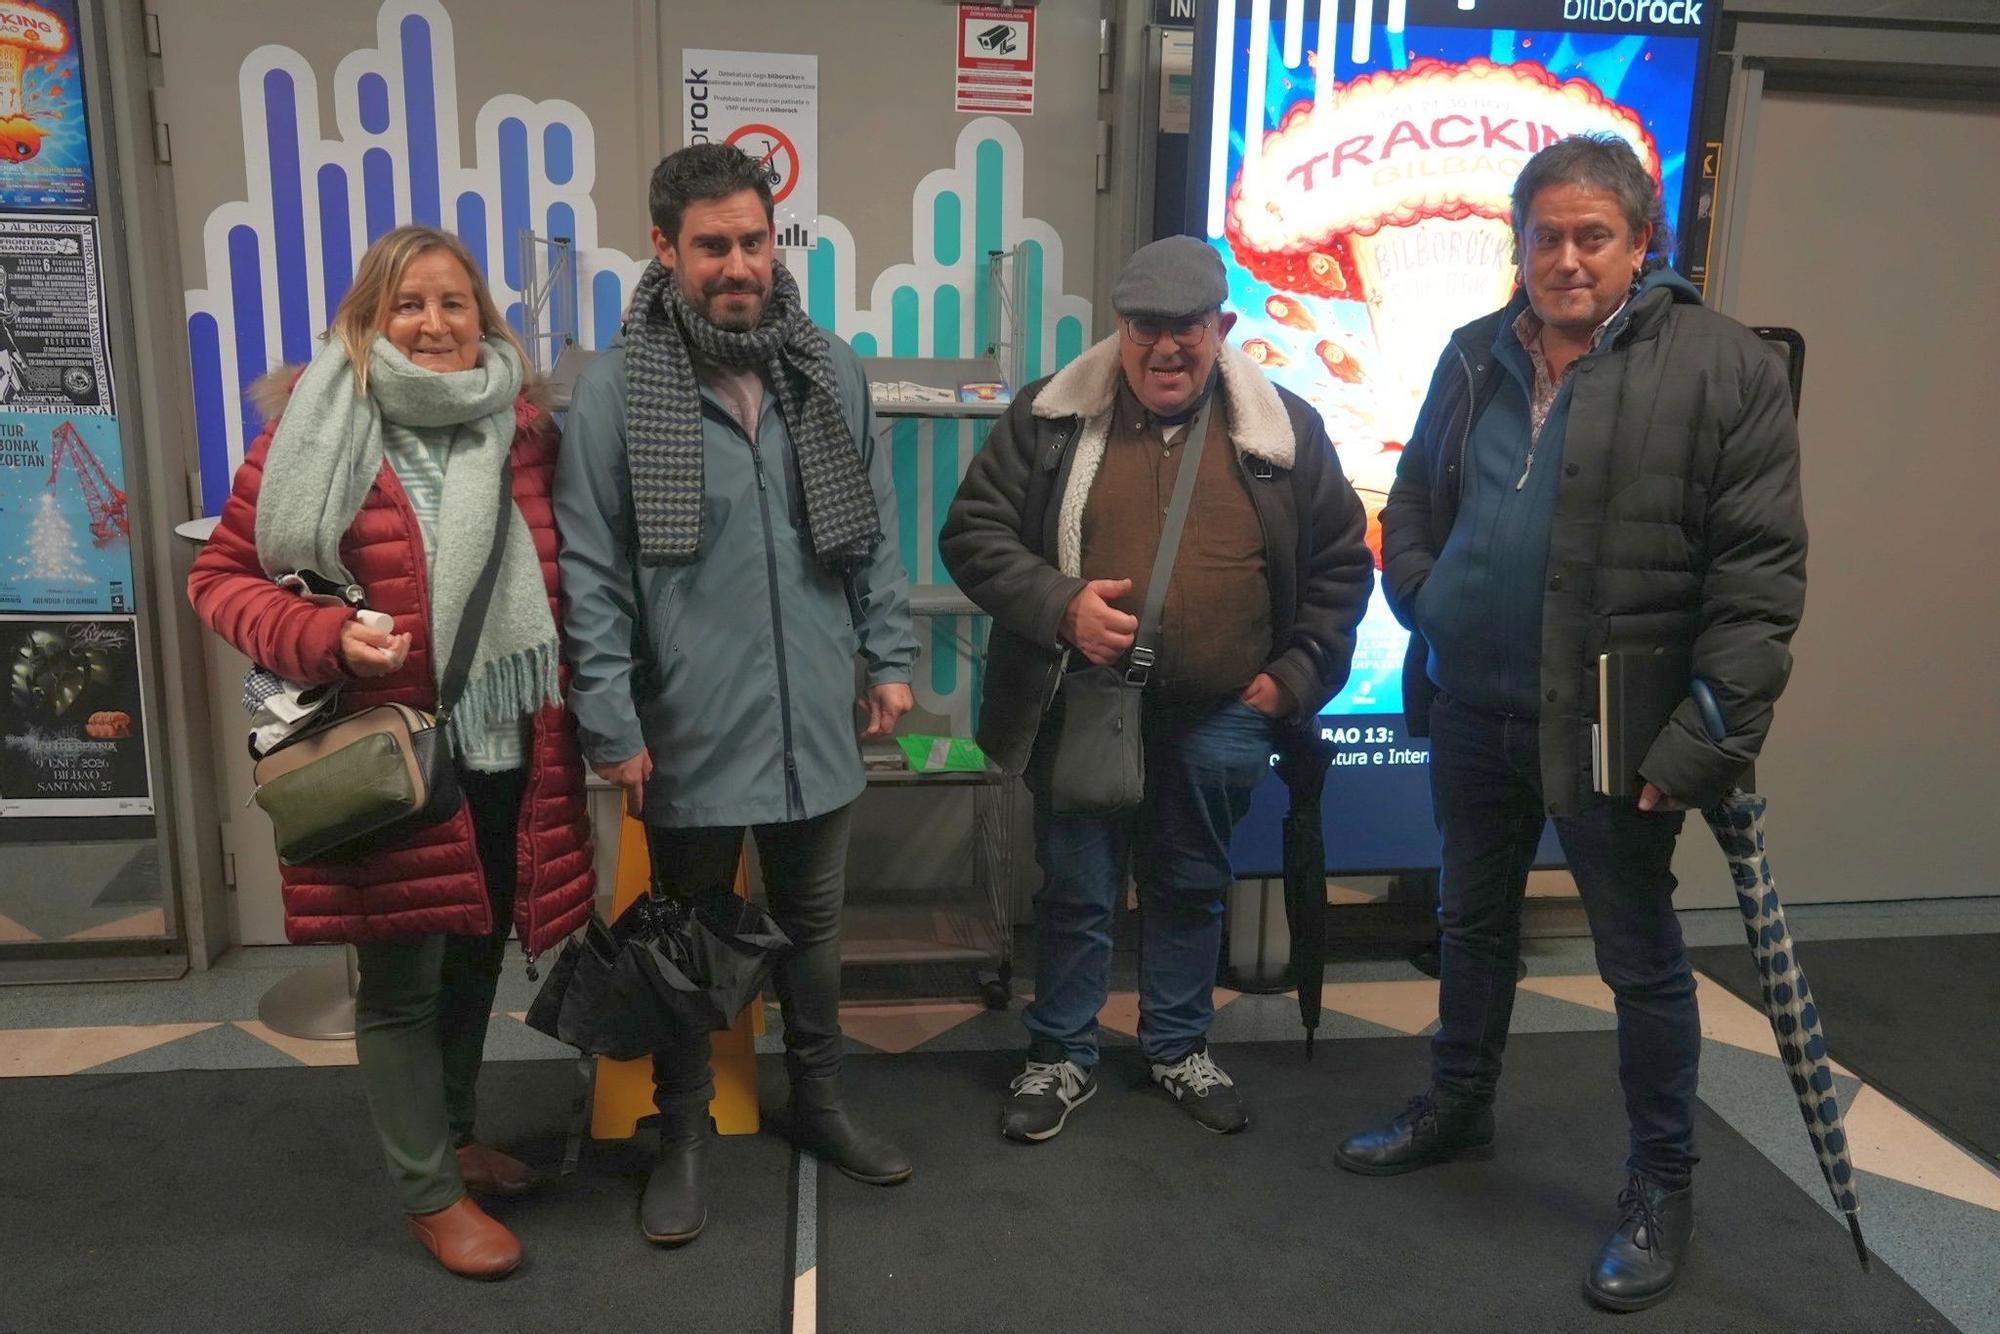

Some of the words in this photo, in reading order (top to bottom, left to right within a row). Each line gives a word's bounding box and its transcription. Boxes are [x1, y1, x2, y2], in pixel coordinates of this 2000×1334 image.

[1563, 0, 1702, 25] bilborock
[43, 258, 51, 272] 6
[1364, 727, 1394, 743] 13:
[1331, 751, 1368, 766] tura
[1372, 751, 1383, 765] e
[53, 770, 100, 780] BILBAO
[37, 781, 97, 792] SANTANA
